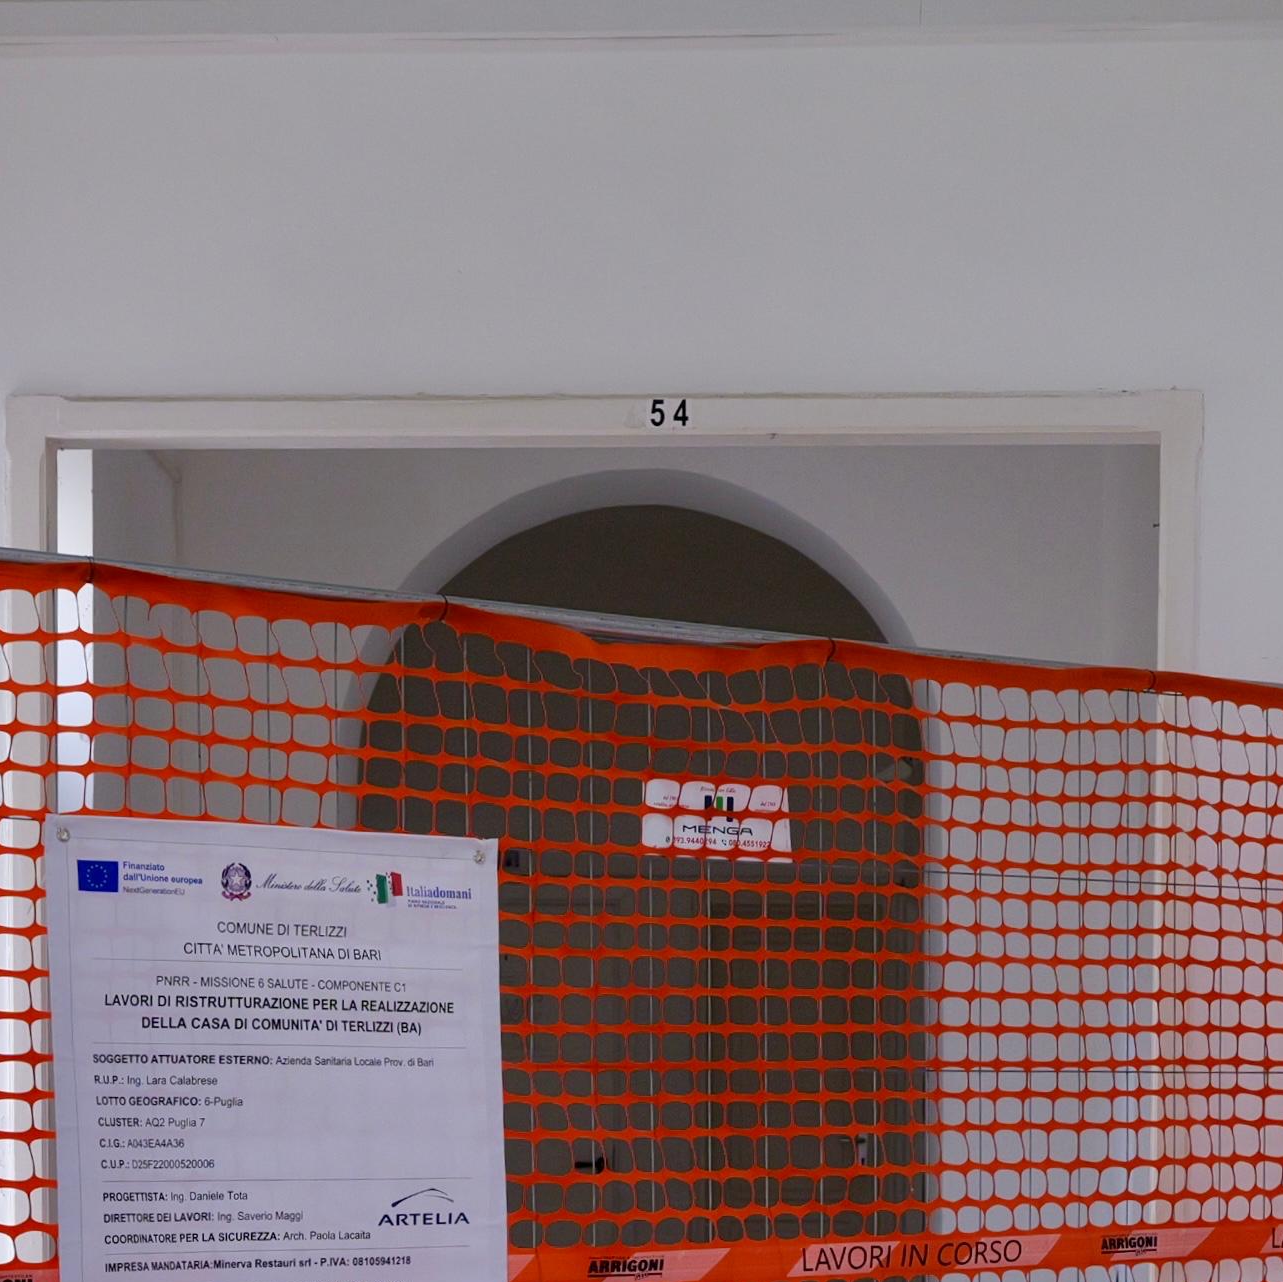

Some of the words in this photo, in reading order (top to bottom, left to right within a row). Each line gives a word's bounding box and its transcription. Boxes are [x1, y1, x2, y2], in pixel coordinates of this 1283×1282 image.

[651, 399, 688, 426] 54
[683, 825, 752, 836] MENGA
[123, 861, 165, 871] Finanziato
[123, 873, 169, 882] dall'Unione
[171, 876, 203, 886] europea
[406, 886, 472, 900] Italiadomani
[218, 921, 274, 936] COMUNE
[278, 924, 290, 936] DI
[294, 924, 347, 938] TERLIZZI
[183, 942, 224, 956] CITTA'
[228, 944, 336, 960] METROPOLITANA
[338, 948, 350, 960] DI
[354, 948, 381, 961] BARI
[156, 975, 190, 987] PNRR
[200, 976, 254, 988] MISSIONE
[258, 978, 264, 989] 6
[268, 978, 308, 990] SALUTE
[318, 979, 391, 992] COMPONENTE
[394, 981, 406, 992] C1
[105, 993, 154, 1008] LAVORI
[157, 996, 172, 1008] DI
[176, 996, 309, 1011] RISTRUTTURAZIONE
[313, 998, 338, 1012] PER
[342, 999, 357, 1012] LA
[361, 999, 454, 1014] REALIZZAZIONE
[142, 1016, 186, 1030] DELLA
[190, 1017, 232, 1030] CASA
[236, 1018, 249, 1031] DI
[252, 1018, 323, 1032] COMUNITA'
[326, 1020, 338, 1032] DI
[342, 1020, 394, 1033] TERLIZZI
[397, 1021, 422, 1035] (BA)
[92, 1054, 149, 1065] SOGGETTO
[151, 1054, 215, 1065] ATTUATORE
[219, 1055, 272, 1066] ESTERNO:
[276, 1056, 311, 1067] Azienda
[314, 1056, 351, 1067] Sanitaria
[354, 1057, 381, 1067] Locale
[384, 1057, 404, 1067] Prov.
[408, 1057, 415, 1067] di
[417, 1057, 434, 1068] Bari
[127, 1076, 143, 1087] Ing.
[146, 1076, 166, 1086] Lara
[169, 1076, 218, 1086] Calabrese
[96, 1096, 126, 1106] LOTTO
[129, 1096, 201, 1107] GEOGRAFICO:
[204, 1097, 243, 1109] 6-Puglia
[98, 1117, 142, 1128] CLUSTER:
[145, 1117, 165, 1128] AQ2
[168, 1117, 197, 1129] Puglia
[199, 1117, 205, 1128] 7
[103, 1191, 167, 1201] PROGETTISTA:
[171, 1191, 186, 1202] Ing.
[190, 1191, 224, 1201] Daniele
[227, 1190, 248, 1200] Tota
[104, 1211, 155, 1223] DIRETTORE
[157, 1212, 172, 1222] DEI
[174, 1211, 214, 1222] LAVORI:
[218, 1211, 234, 1223] Ing.
[237, 1211, 272, 1221] Saverio
[275, 1210, 303, 1223] Maggi
[378, 1213, 469, 1226] ARTELIA
[104, 1232, 177, 1244] COORDINATORE
[180, 1232, 199, 1243] PER
[202, 1232, 215, 1242] LA
[218, 1231, 281, 1242] SICUREZZA:
[283, 1231, 306, 1241] Arch.
[310, 1230, 336, 1241] Paola
[339, 1230, 371, 1240] Lacaita
[1102, 1236, 1157, 1250] ARRIGONI
[802, 1242, 892, 1272] LAVORI
[901, 1243, 934, 1268] IN
[937, 1239, 1022, 1267] CORSO
[105, 1262, 149, 1272] IMPRESA
[255, 1258, 295, 1269] Restauri
[299, 1258, 311, 1268] srl
[352, 1256, 411, 1267] 08105941218
[588, 1259, 664, 1273] ARRIGONI
